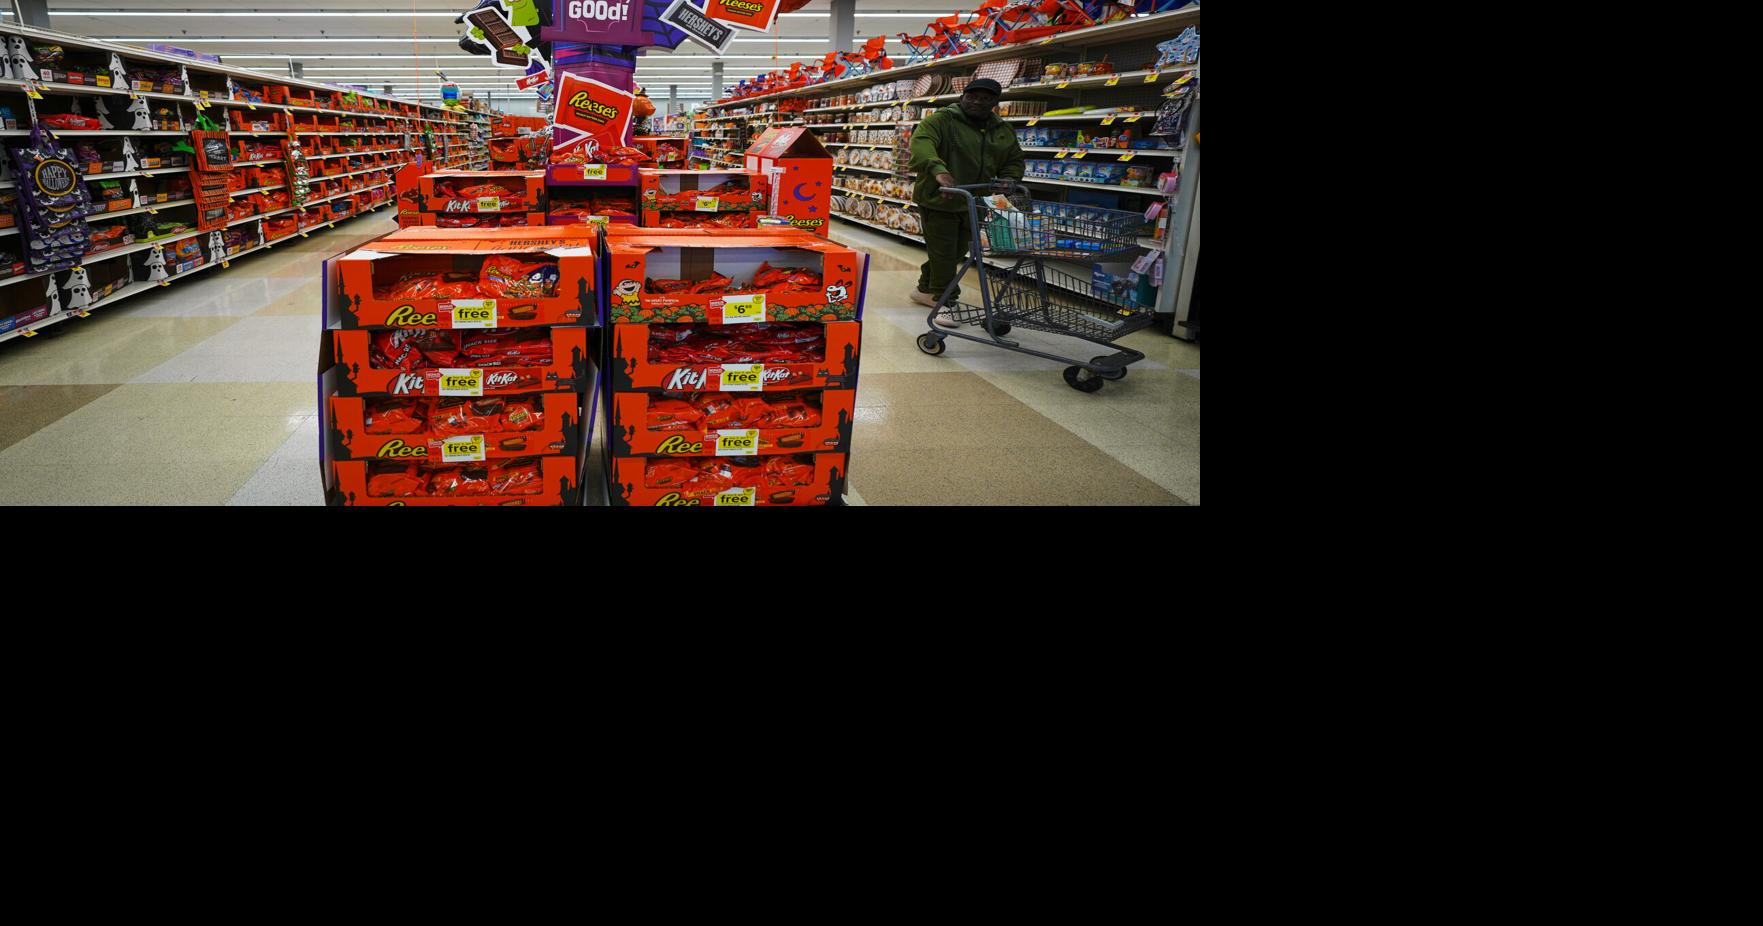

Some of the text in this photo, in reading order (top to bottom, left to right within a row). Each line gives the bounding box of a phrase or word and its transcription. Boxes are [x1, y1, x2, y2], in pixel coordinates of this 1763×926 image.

[678, 9, 724, 41] HERSHEY'S
[569, 91, 618, 119] Reese's
[42, 165, 68, 178] HAPPY
[458, 308, 489, 318] free
[446, 377, 477, 386] free
[727, 373, 757, 381] free
[393, 373, 425, 394] Kit
[722, 438, 751, 446] free
[448, 444, 478, 453] free
[721, 495, 748, 503] free
